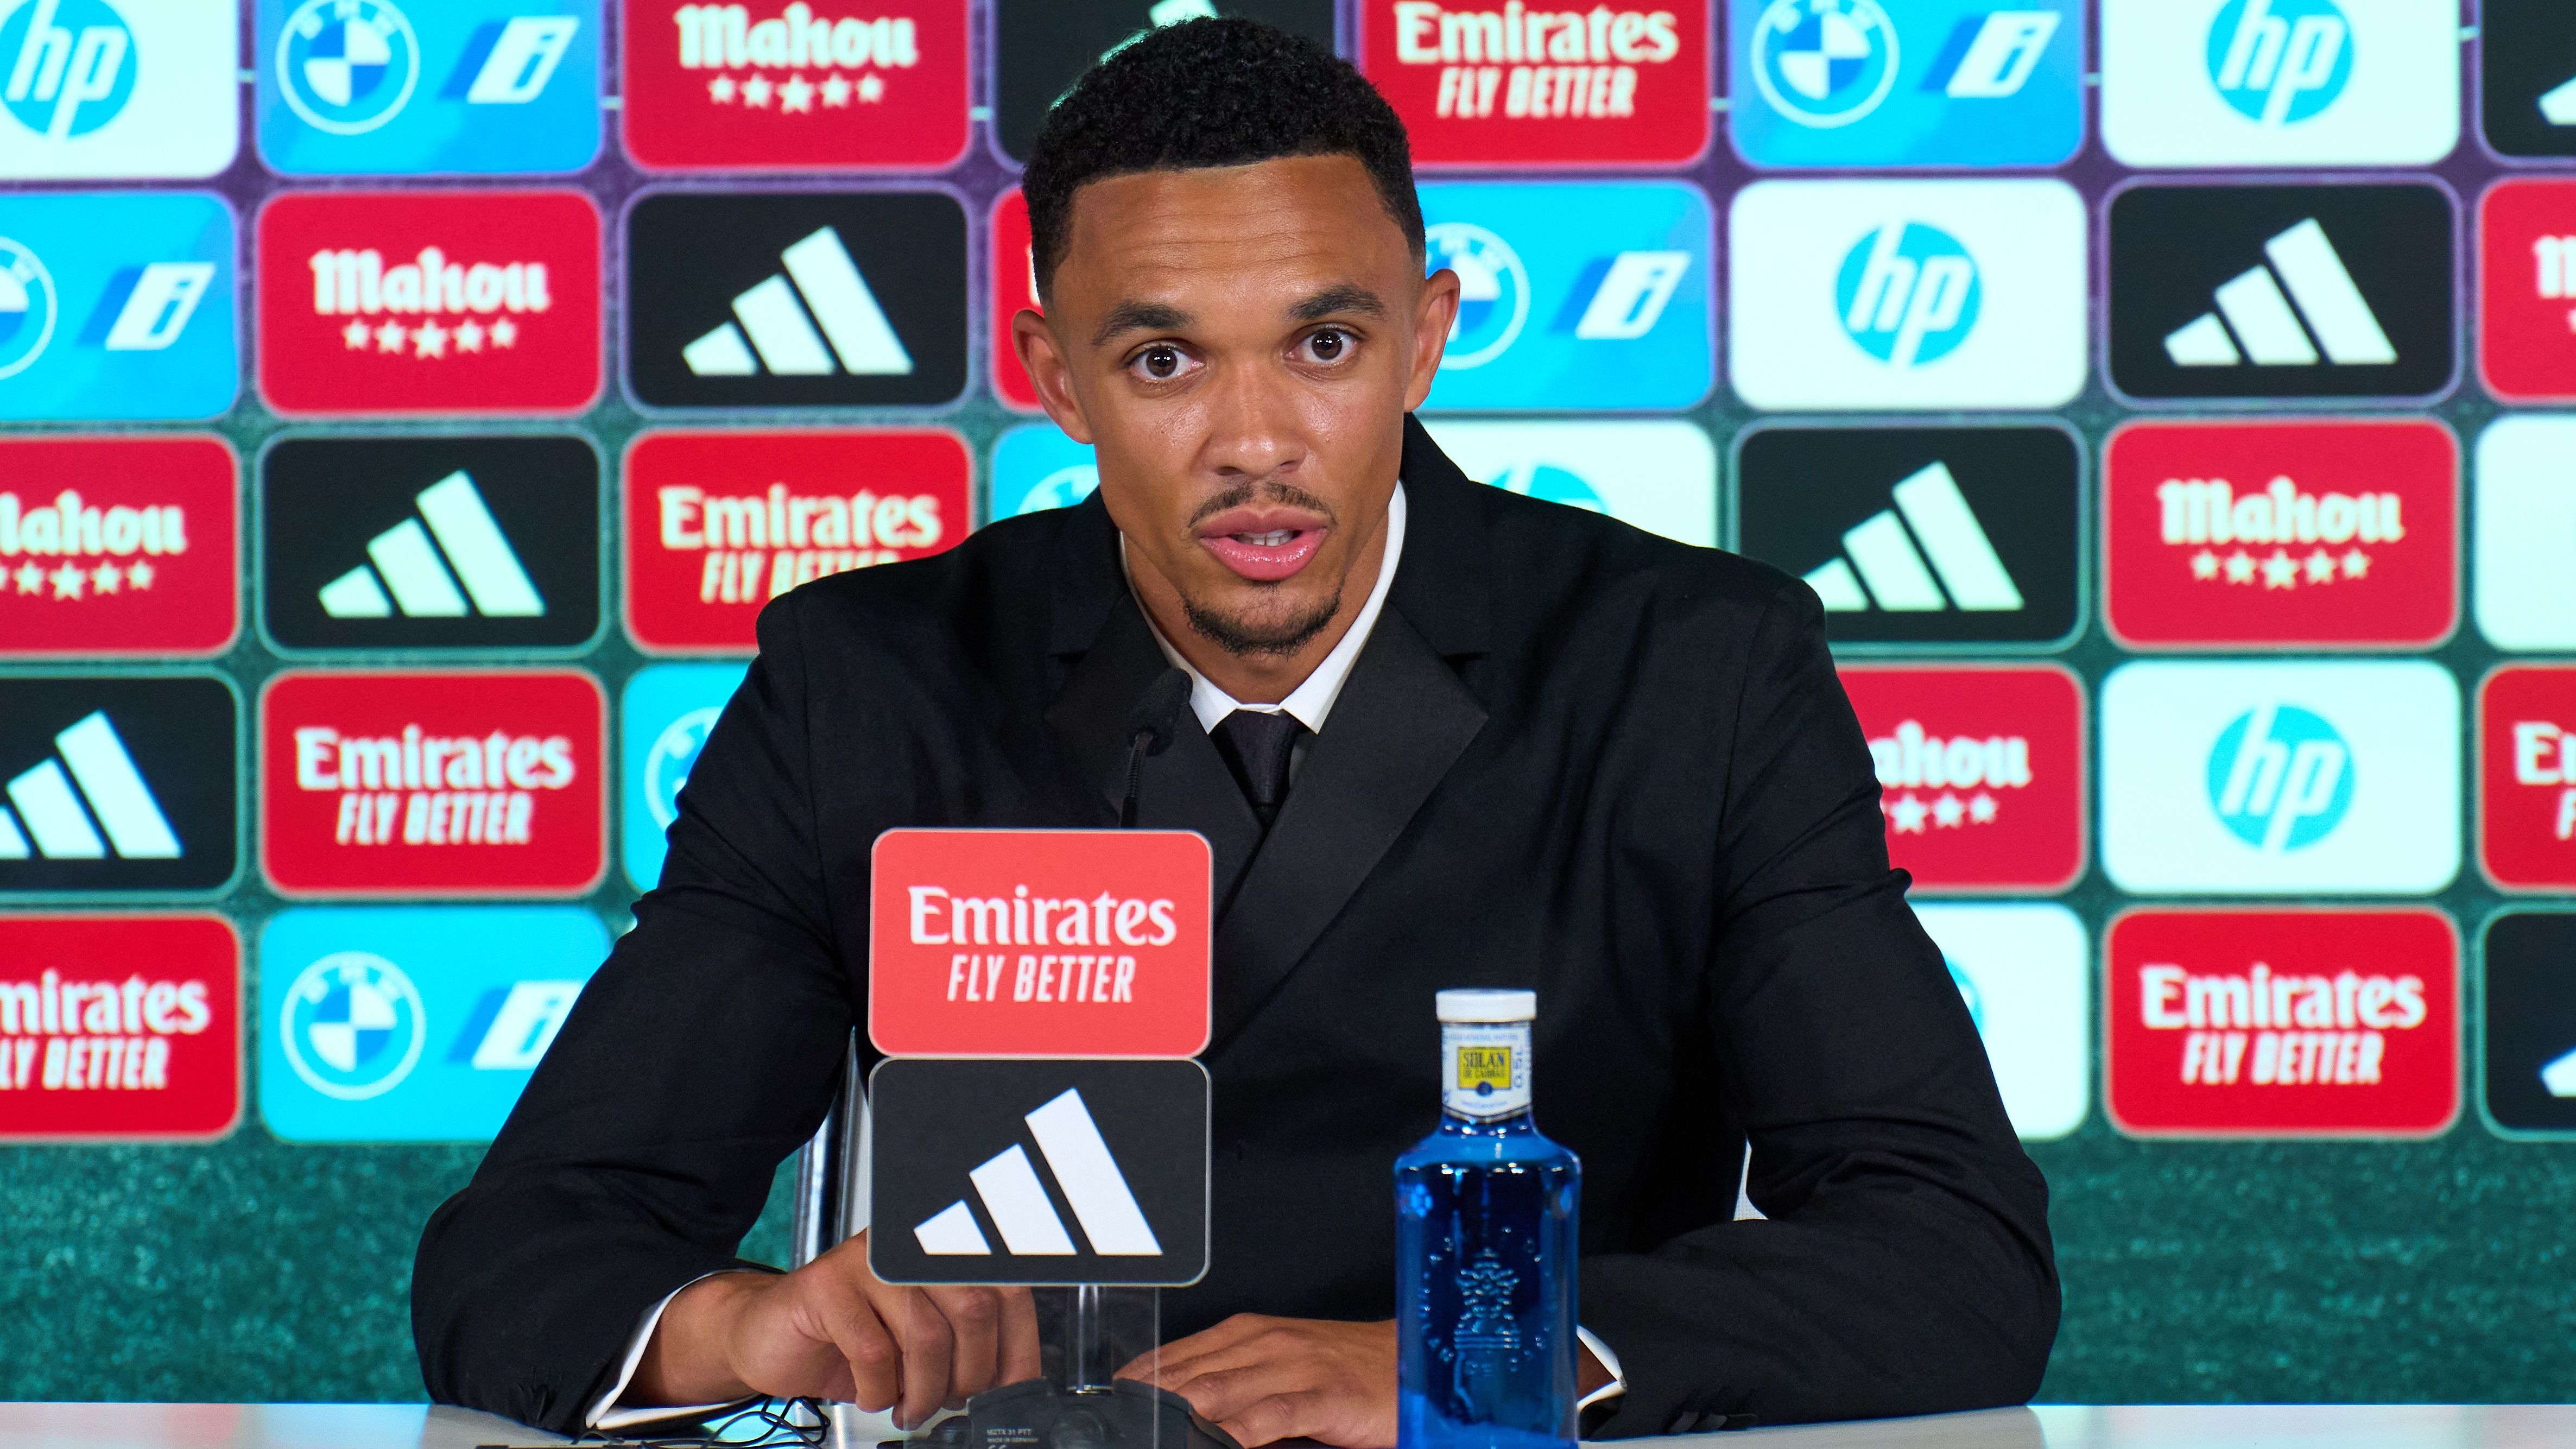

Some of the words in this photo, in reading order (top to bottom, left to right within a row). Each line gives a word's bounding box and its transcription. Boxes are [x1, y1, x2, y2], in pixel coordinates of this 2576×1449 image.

[674, 2, 919, 68] Mahou
[1395, 0, 1679, 64] Emirates
[2217, 0, 2347, 126] hp
[1436, 66, 1502, 118] FLY
[1505, 66, 1637, 118] BETTER
[310, 247, 550, 314] Mahou
[1847, 220, 1975, 369] hp
[660, 483, 942, 548] Emirates
[2157, 476, 2404, 544] Mahou
[701, 550, 765, 603] FLY
[295, 724, 574, 789] Emirates
[1866, 720, 2032, 788] ahou
[2218, 705, 2347, 850] hp
[337, 792, 399, 845] FLY
[404, 792, 533, 845] BETTER
[908, 884, 1177, 946] Emirates
[0, 969, 210, 1034] mirates
[947, 954, 1005, 1002] FLY
[1013, 955, 1136, 1003] BETTER
[2140, 964, 2426, 1029] Emirates
[0, 1038, 37, 1090] LY
[43, 1037, 169, 1090] BETTER
[2181, 1032, 2248, 1085] FLY
[2251, 1032, 2384, 1085] BETTER
